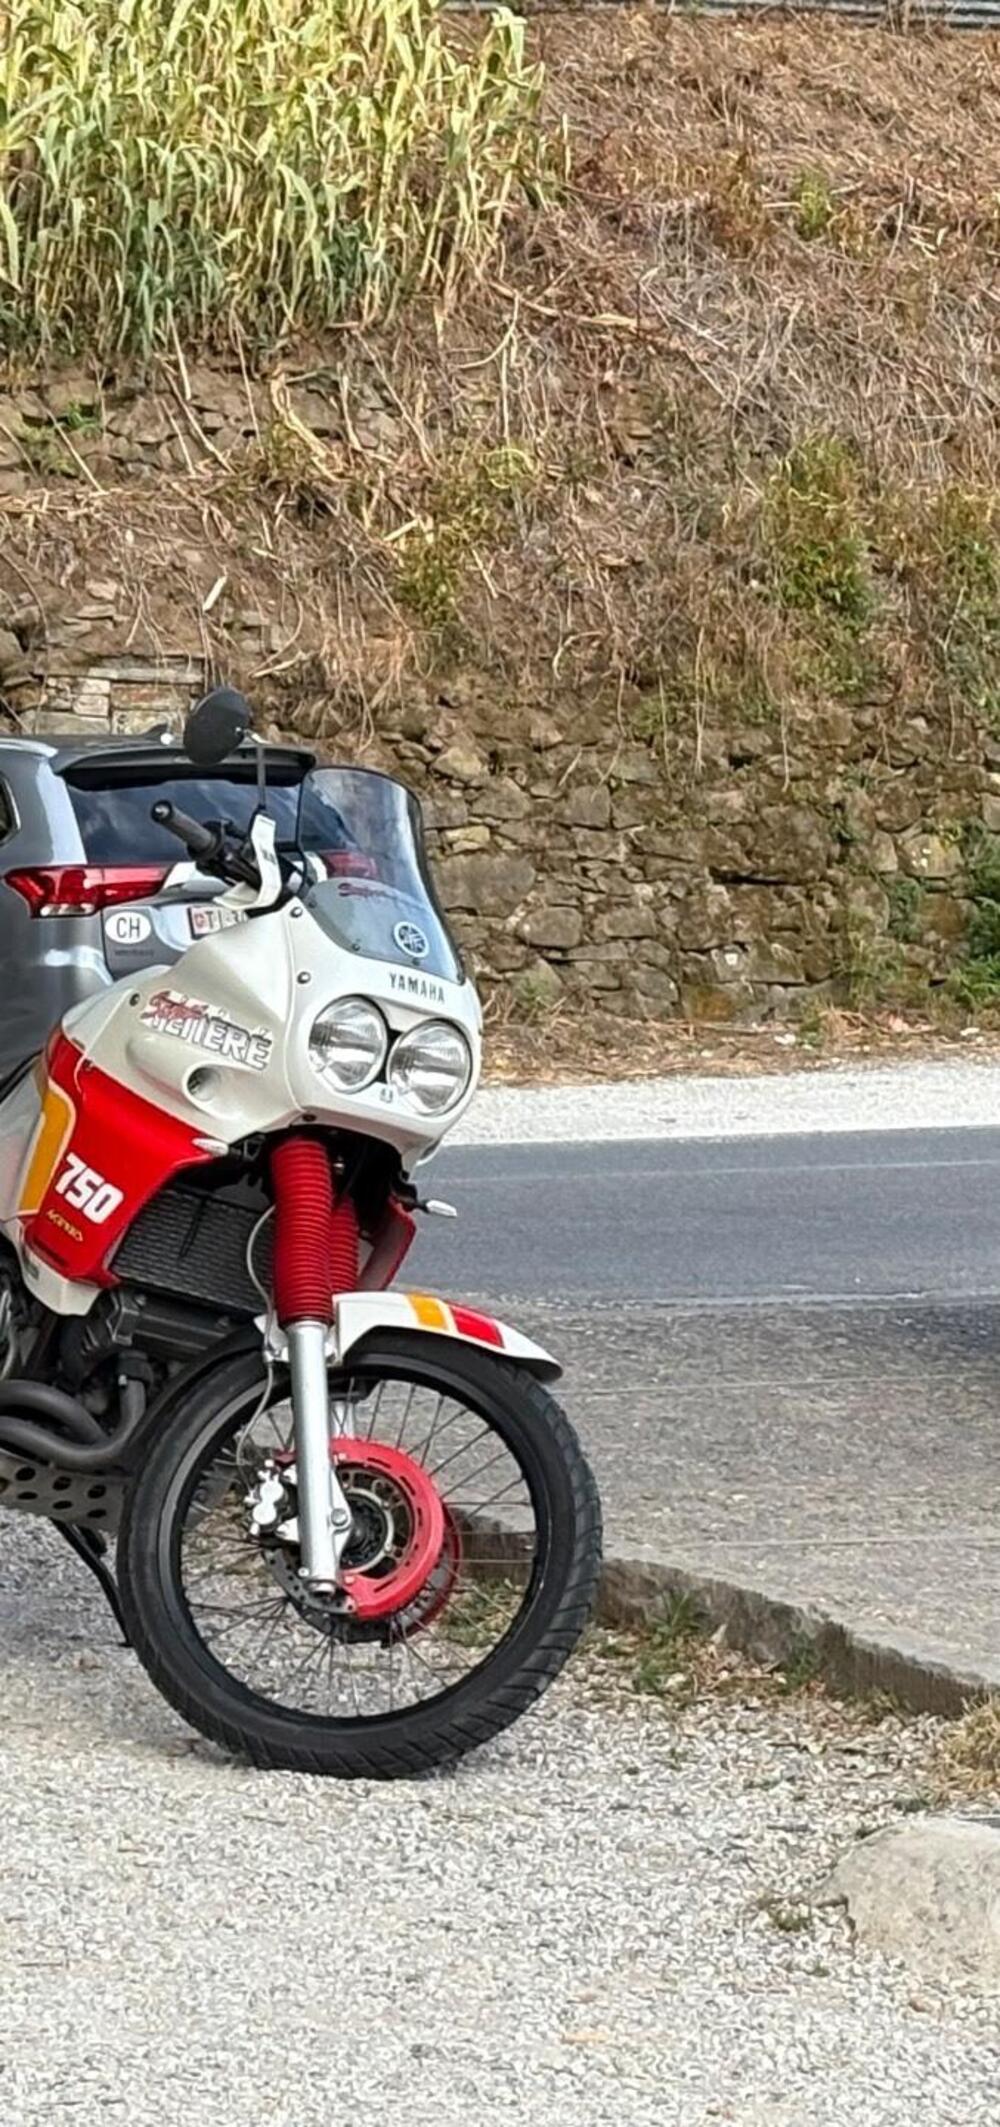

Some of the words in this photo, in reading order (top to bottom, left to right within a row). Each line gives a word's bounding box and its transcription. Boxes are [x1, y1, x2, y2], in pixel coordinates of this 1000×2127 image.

[116, 917, 141, 938] CH
[389, 972, 446, 1003] YAMAHA
[55, 1152, 124, 1224] 750
